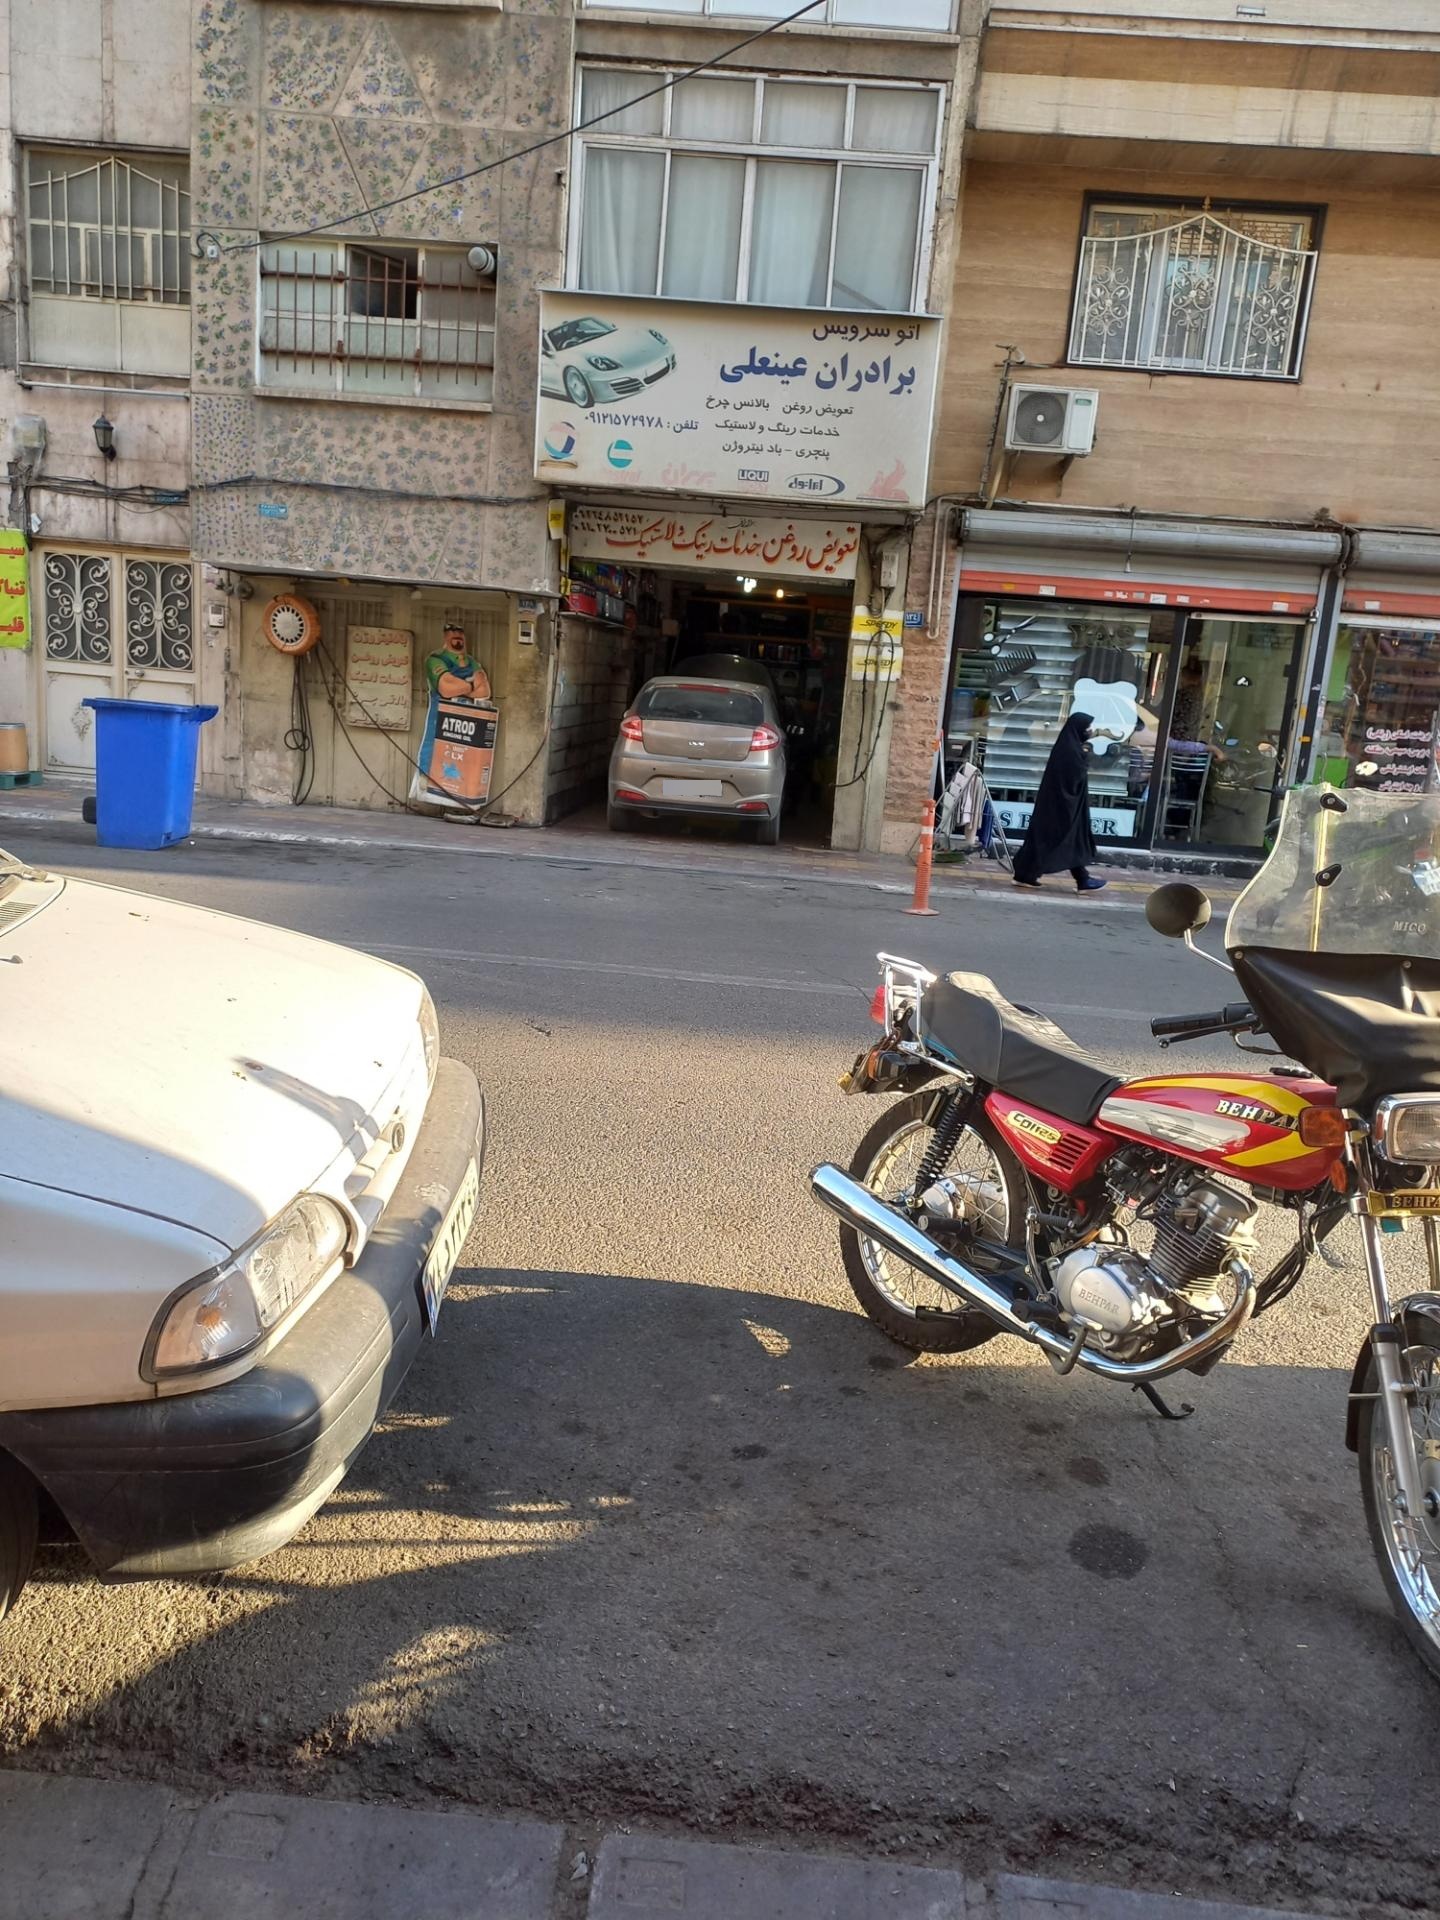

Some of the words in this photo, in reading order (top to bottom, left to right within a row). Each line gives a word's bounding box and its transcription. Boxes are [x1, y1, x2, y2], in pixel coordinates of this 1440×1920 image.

[812, 323, 890, 341] سرویس
[894, 323, 920, 346] اتو
[719, 345, 808, 386] عینعلی
[815, 352, 916, 395] برادران
[705, 395, 730, 409] چرخ
[733, 398, 770, 412] بالانس
[782, 402, 812, 415] روغن
[815, 403, 854, 417] تعویض
[799, 424, 840, 437] خدمات
[722, 440, 763, 455] نیتروژن
[739, 470, 769, 482] LIQUI
[712, 529, 762, 558] خدمات
[762, 524, 806, 563] روغن
[806, 526, 858, 573] تعویض
[442, 717, 476, 735] ATROD
[1079, 1288, 1120, 1313] BEHPAR
